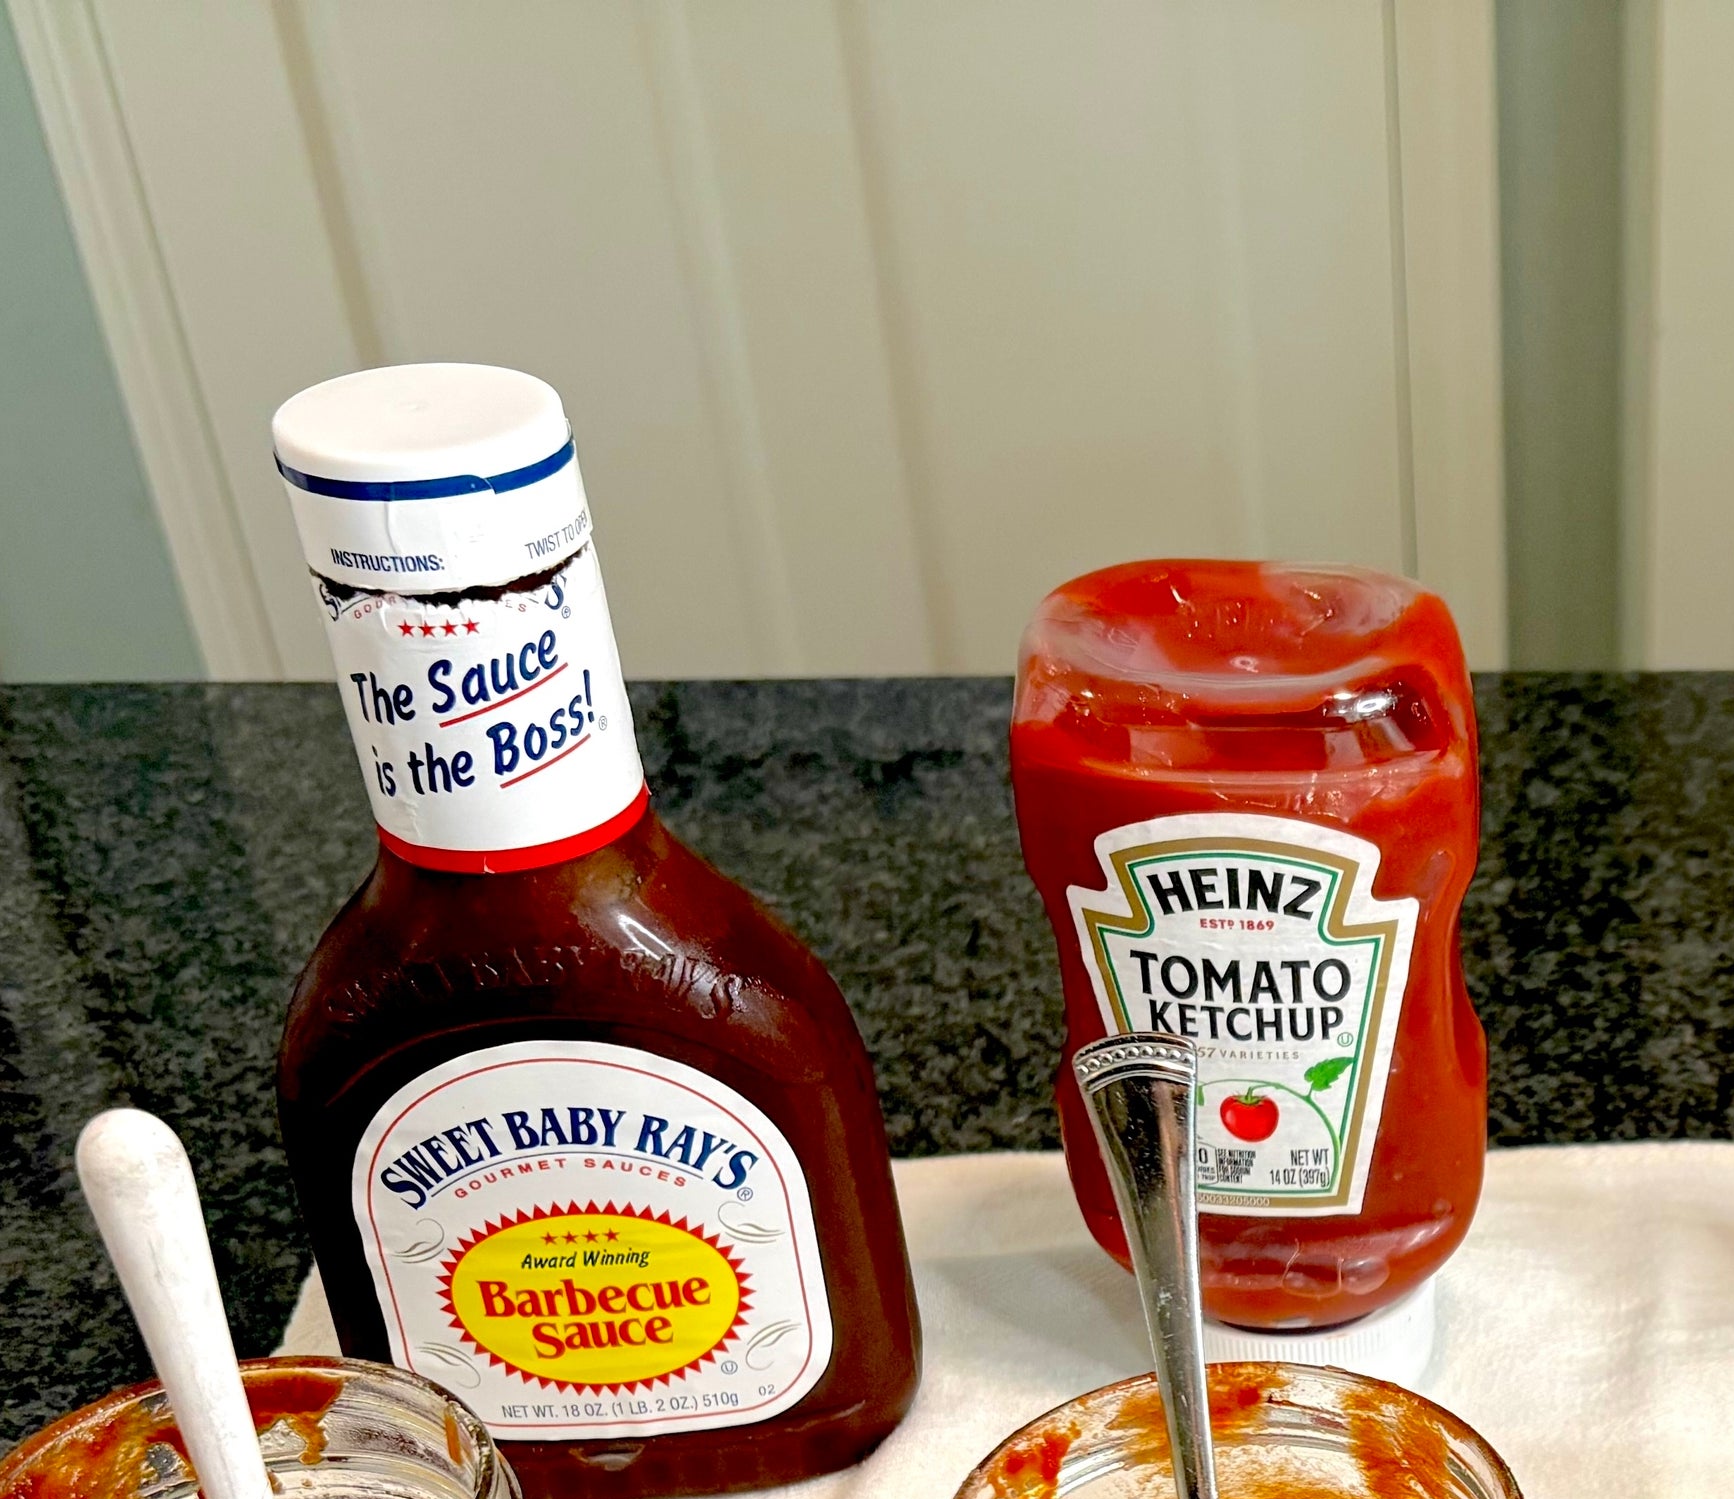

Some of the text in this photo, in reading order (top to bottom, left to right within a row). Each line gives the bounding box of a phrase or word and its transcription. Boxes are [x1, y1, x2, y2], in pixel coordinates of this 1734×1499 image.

[330, 548, 445, 572] INSTRUCTIONS:
[524, 531, 560, 559] TWIST
[561, 523, 574, 543] TO
[350, 629, 559, 727] The Sauce
[371, 669, 596, 797] is the Boss!
[1146, 867, 1322, 921] HEINZ
[1239, 919, 1274, 931] 1869
[1129, 949, 1352, 1004] TOMATO
[1148, 998, 1344, 1042] KETCHUP
[1198, 1047, 1300, 1060] 57 VARIETIES
[380, 1106, 759, 1211] SWEET BABY RAY'S
[454, 1158, 686, 1199] GOURMET SAUCES
[1270, 1168, 1330, 1188] 14 OZ (397g)
[1290, 1149, 1329, 1167] NET WT
[520, 1247, 650, 1270] Award Winning
[475, 1275, 711, 1318] Barbecue
[531, 1314, 674, 1361] Sauce
[502, 1391, 739, 1418] NET WT. 18 OZ. (1 LB. 2 OZ.) 510g
